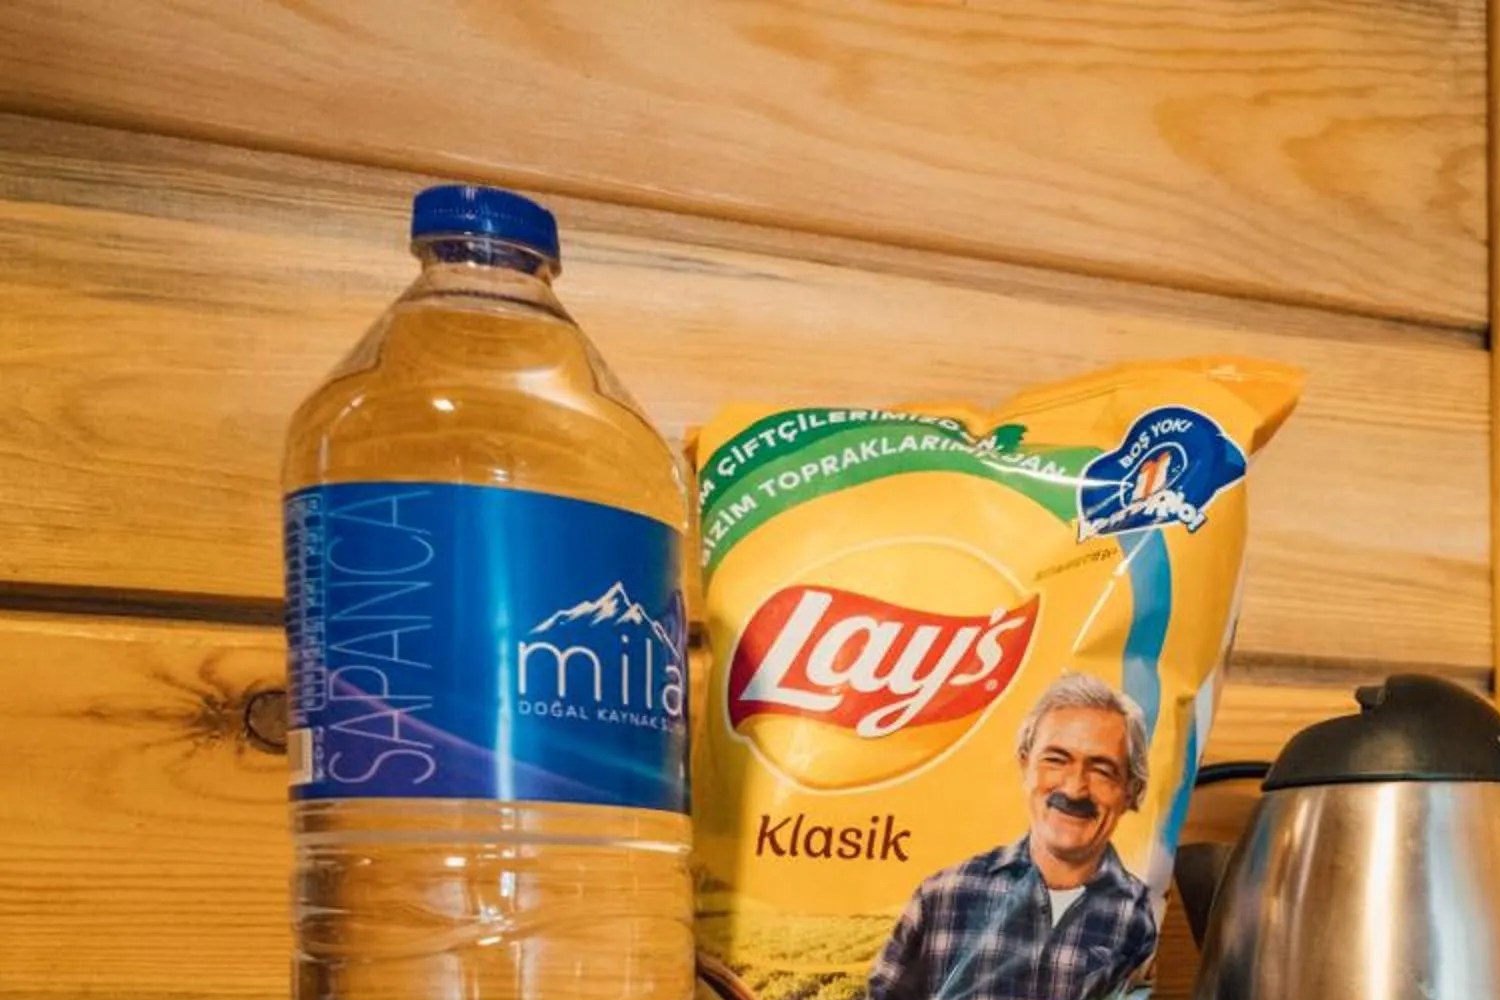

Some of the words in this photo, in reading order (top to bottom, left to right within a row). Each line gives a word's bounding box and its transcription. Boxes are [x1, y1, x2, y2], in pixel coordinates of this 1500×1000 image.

[1119, 431, 1151, 469] BOŞ
[328, 490, 436, 785] SAPANCA
[740, 590, 1026, 738] Lay's
[518, 700, 590, 721] DOĞAL
[756, 814, 911, 862] Klasik
